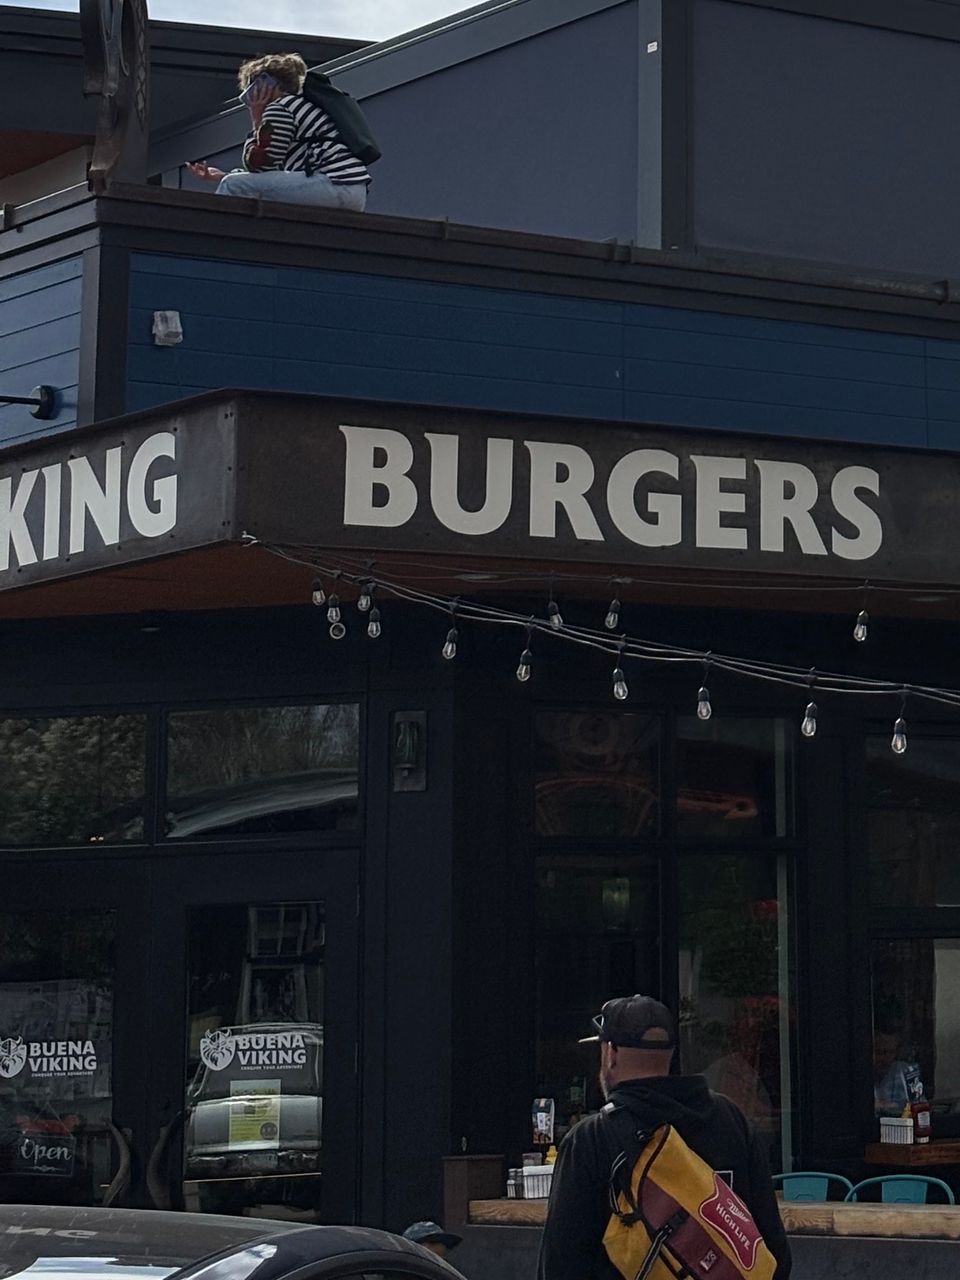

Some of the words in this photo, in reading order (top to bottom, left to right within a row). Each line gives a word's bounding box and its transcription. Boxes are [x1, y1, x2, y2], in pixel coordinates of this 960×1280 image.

[338, 425, 884, 561] BURGERS
[28, 1040, 96, 1057] BUENA
[238, 1034, 305, 1050] BUENA
[28, 1055, 97, 1072] VIKING
[237, 1049, 307, 1065] VIKING
[20, 1138, 72, 1165] Open
[715, 1202, 736, 1230] HIGH
[733, 1227, 752, 1251] LIFE
